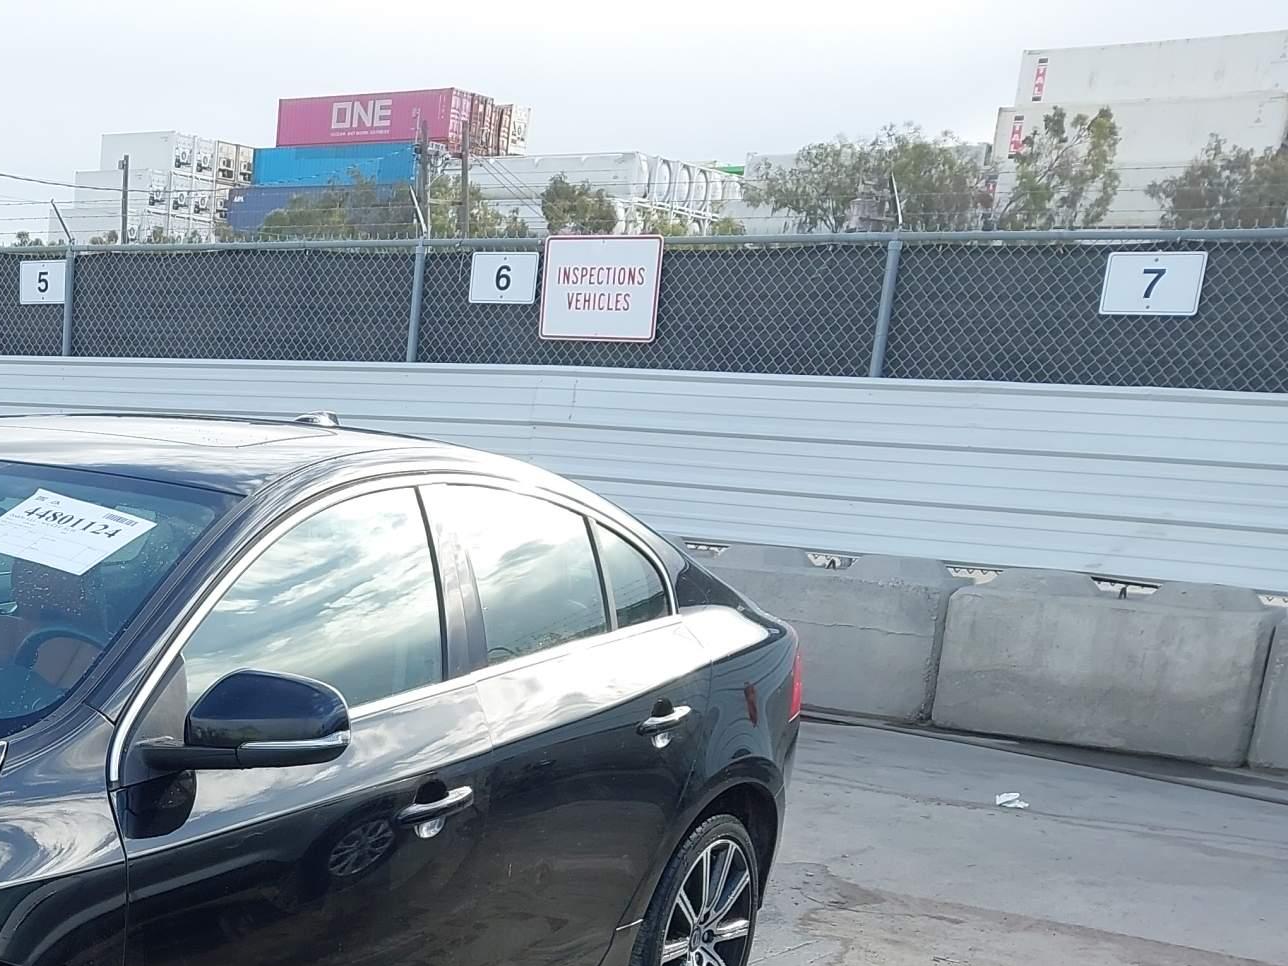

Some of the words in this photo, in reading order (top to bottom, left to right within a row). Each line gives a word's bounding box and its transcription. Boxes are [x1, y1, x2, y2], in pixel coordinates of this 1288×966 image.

[332, 99, 392, 129] ONE
[37, 271, 49, 293] 5
[495, 265, 512, 291] 6
[557, 266, 646, 286] INSPECTIONS
[1143, 268, 1167, 299] 7
[567, 292, 631, 311] VEHICLES
[24, 506, 122, 538] 44801124
